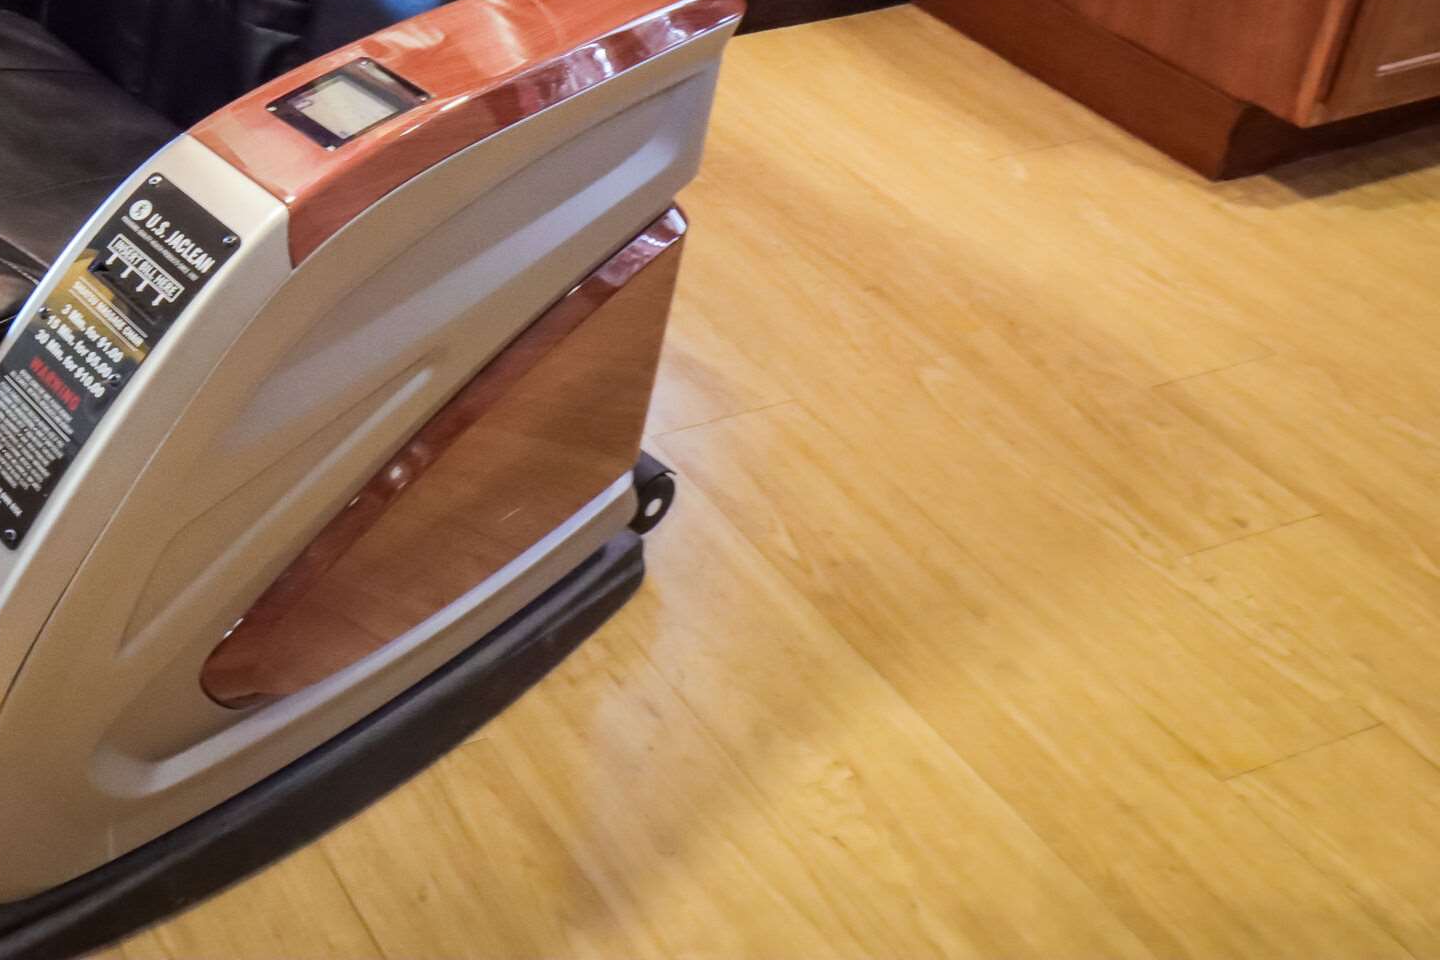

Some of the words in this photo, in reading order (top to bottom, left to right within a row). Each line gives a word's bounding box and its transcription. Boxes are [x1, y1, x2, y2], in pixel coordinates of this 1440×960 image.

[113, 241, 139, 266] INSERT
[138, 261, 156, 280] BILL
[152, 275, 178, 297] HERE
[144, 212, 171, 239] U.S.
[164, 229, 215, 274] JACLEAN
[48, 315, 62, 329] 15
[57, 324, 75, 346] Min.
[73, 340, 89, 357] for
[85, 351, 113, 379] $5.00
[62, 304, 71, 314] 3
[68, 309, 86, 330] Min.
[84, 325, 100, 342] for
[96, 335, 124, 363] $1.00
[123, 325, 144, 346] CHAIR
[31, 356, 81, 411] WARNING
[34, 329, 50, 344] 30
[45, 339, 64, 361] Min.
[63, 356, 78, 372] for
[73, 366, 105, 398] $10.00
